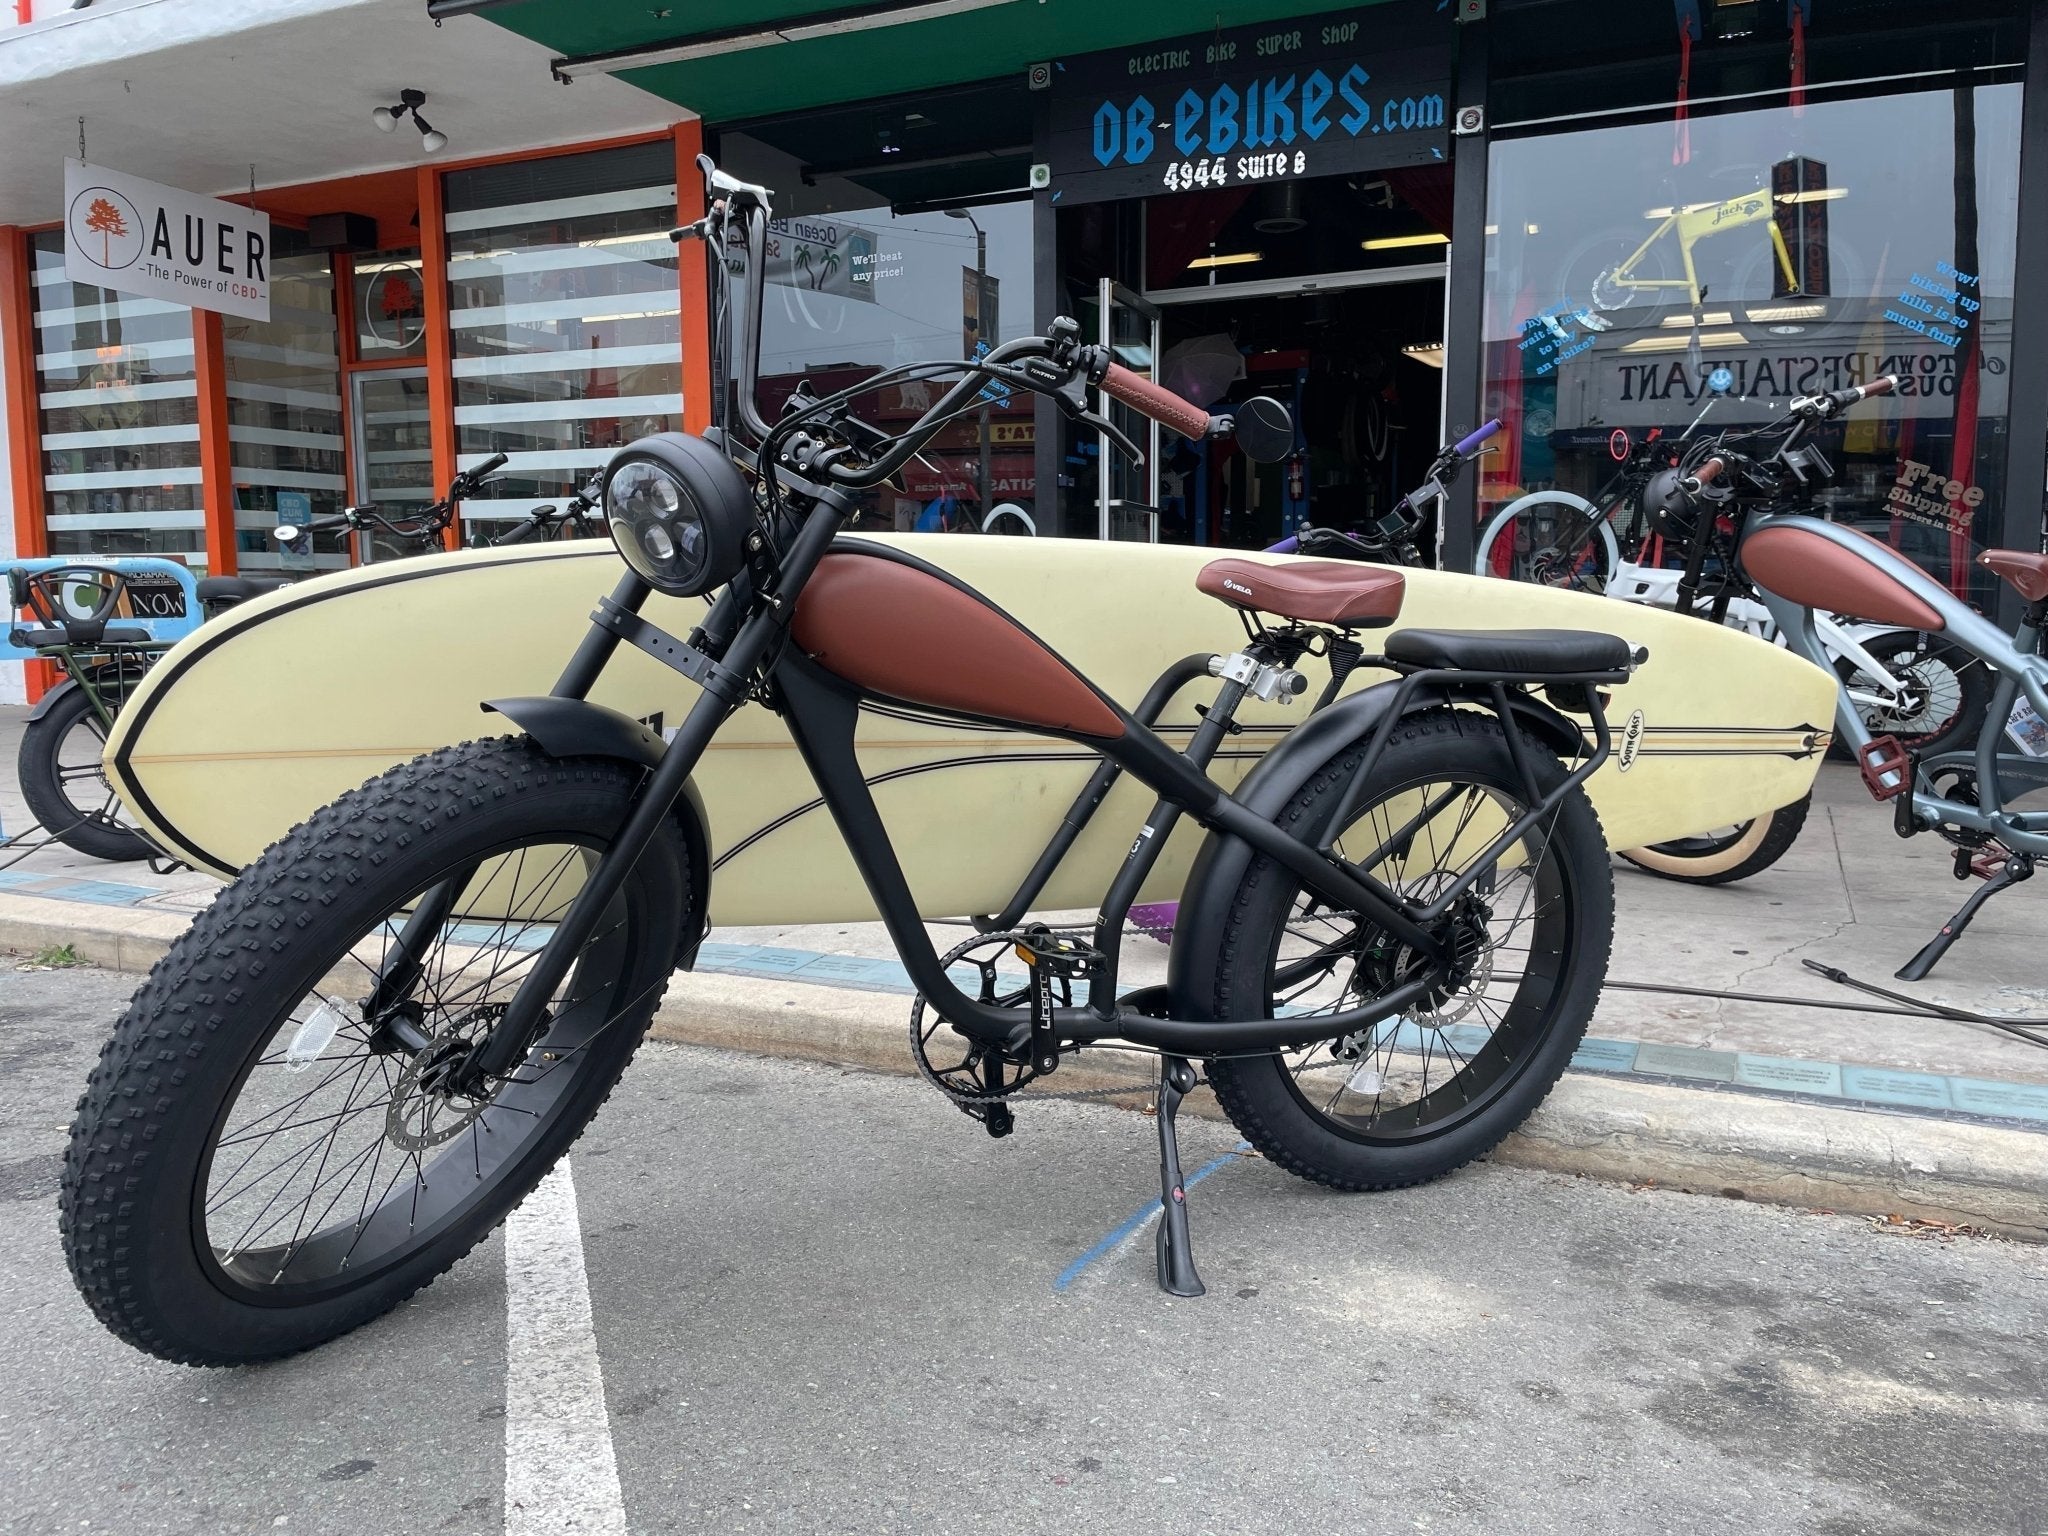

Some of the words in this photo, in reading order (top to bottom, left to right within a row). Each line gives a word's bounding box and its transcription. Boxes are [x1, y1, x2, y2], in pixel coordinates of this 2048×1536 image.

[1163, 157, 1227, 192] 4944
[1293, 150, 1306, 175] B
[1711, 202, 1744, 226] jack
[150, 207, 265, 282] AUER
[852, 254, 877, 266] We'll
[880, 251, 903, 263] beat
[174, 270, 212, 291] Power
[216, 281, 228, 293] of
[852, 272, 872, 282] any
[874, 266, 904, 281] price!
[1936, 260, 1979, 288] Wow!
[1910, 273, 1960, 305] biking
[1960, 297, 1981, 313] up
[1898, 291, 1934, 314] hills
[1934, 306, 1950, 321] is
[1950, 315, 1969, 329] so
[1517, 331, 1546, 351] wait
[1546, 323, 1559, 335] so
[1882, 309, 1926, 334] much
[1926, 326, 1962, 348] fun!
[975, 341, 991, 355] My
[1536, 362, 1553, 375] an
[1553, 335, 1597, 365] e-bike?
[1538, 344, 1553, 356] to
[1552, 330, 1576, 347] buy
[1030, 368, 1057, 380] TEKTRO
[1896, 459, 1984, 507] Free
[1882, 503, 1932, 525] Anywhere
[1933, 519, 1944, 530] in
[1887, 486, 1976, 527] Shipping
[1232, 583, 1252, 595] VELO
[132, 591, 185, 615] NOW
[1626, 715, 1641, 740] COAST
[1620, 741, 1635, 767] SOUTH
